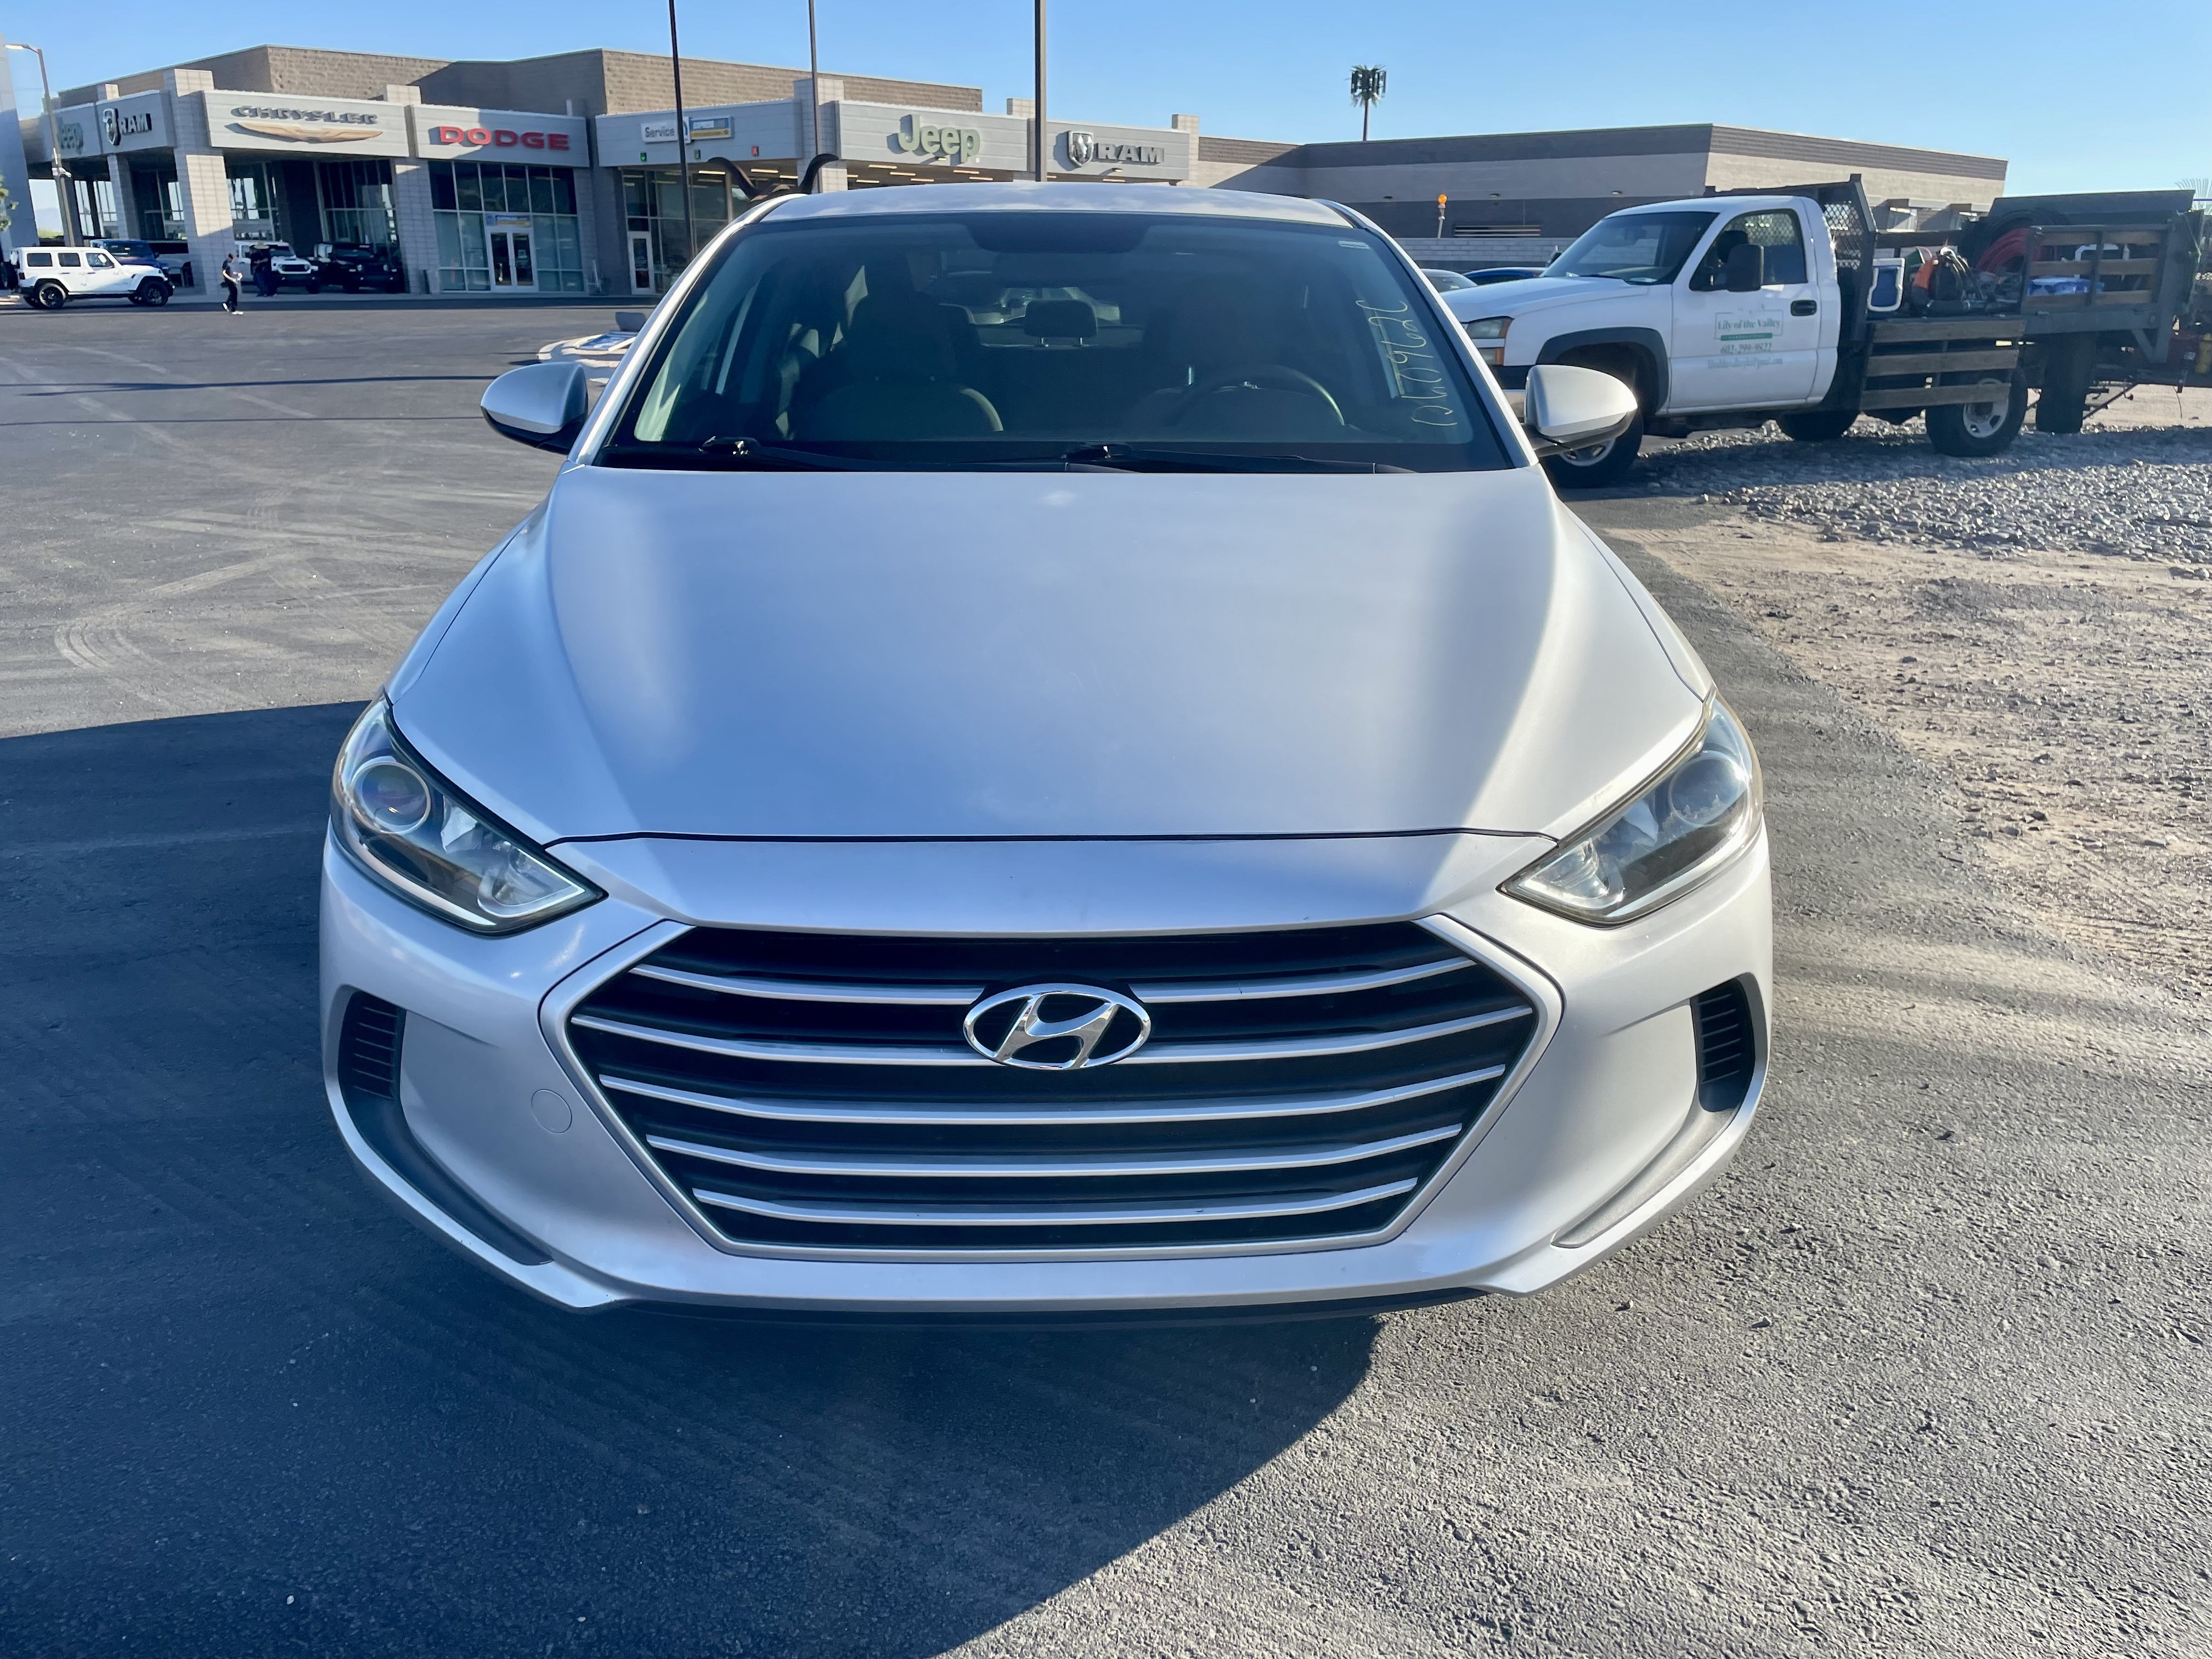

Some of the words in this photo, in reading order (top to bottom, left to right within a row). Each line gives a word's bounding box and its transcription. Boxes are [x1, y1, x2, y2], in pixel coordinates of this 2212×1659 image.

[119, 113, 152, 136] RAM
[232, 106, 377, 125] CHRYSLER
[439, 126, 569, 150] DODGE
[645, 126, 675, 138] Service
[898, 114, 981, 163] Jeep
[1098, 143, 1165, 163] RAM
[1743, 319, 1756, 329] the
[1757, 318, 1780, 329] Valley
